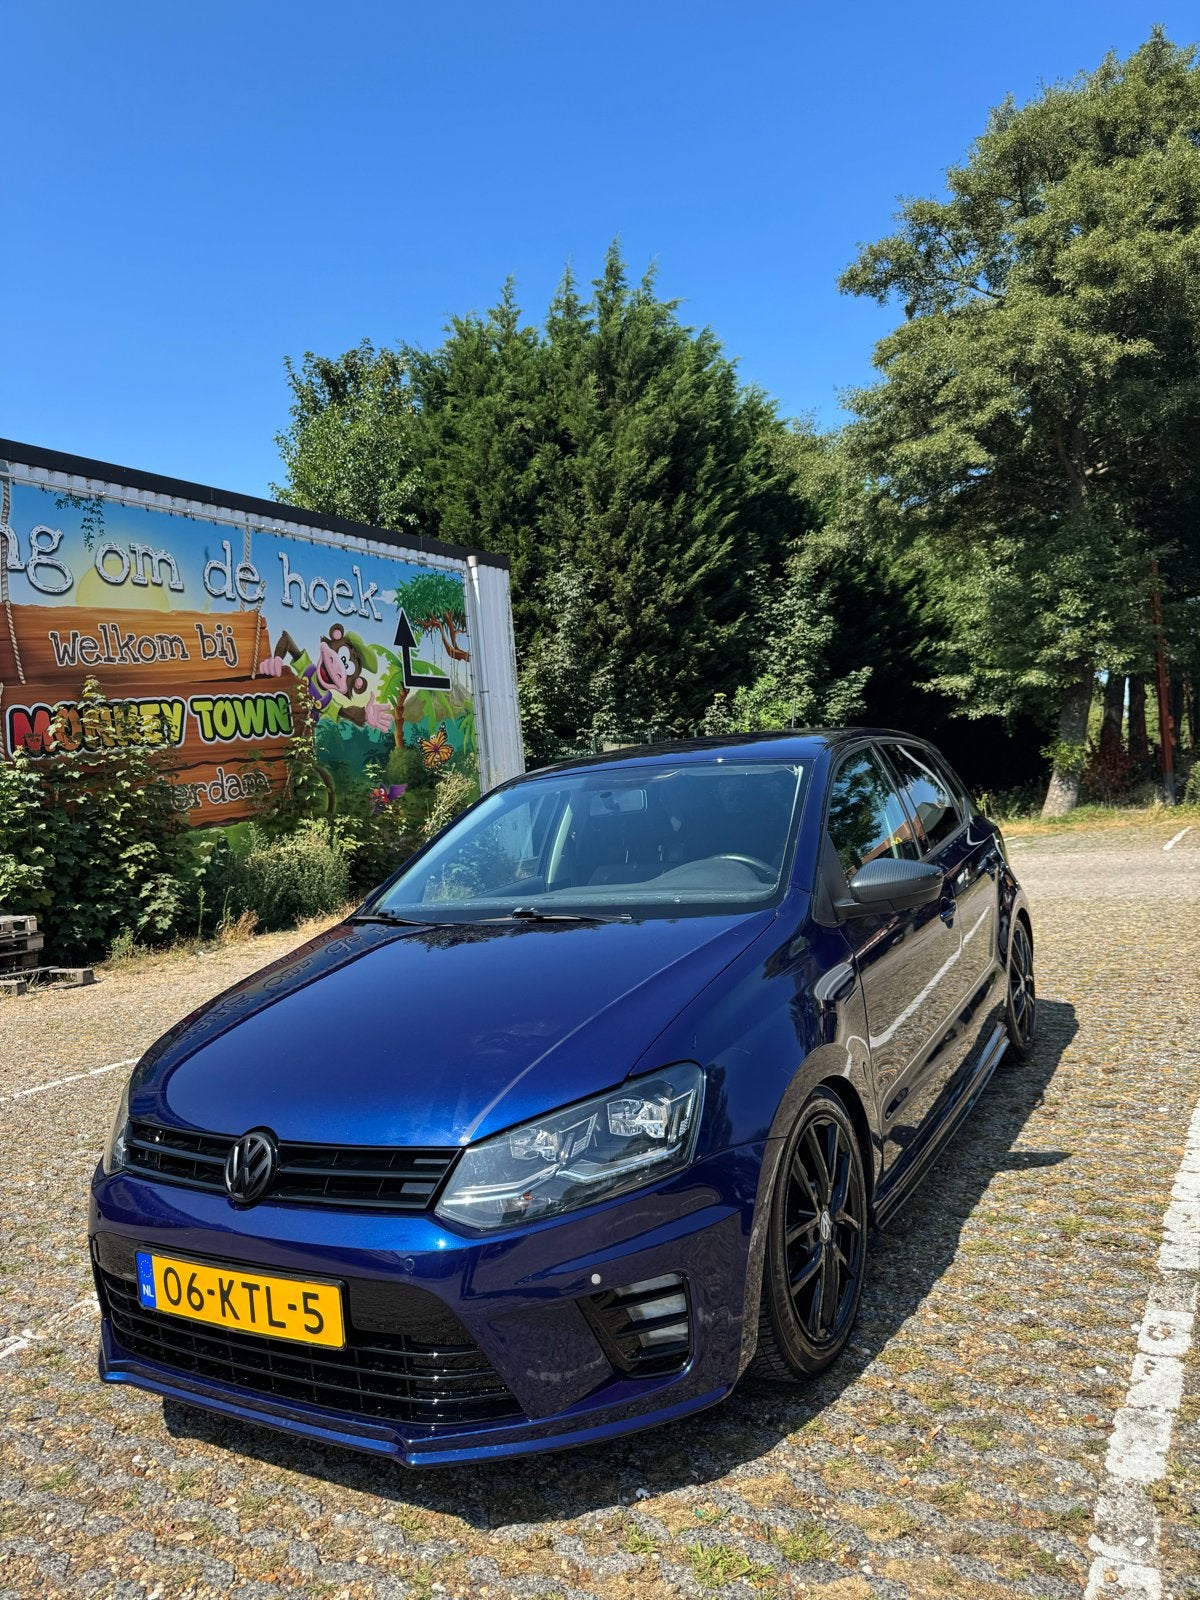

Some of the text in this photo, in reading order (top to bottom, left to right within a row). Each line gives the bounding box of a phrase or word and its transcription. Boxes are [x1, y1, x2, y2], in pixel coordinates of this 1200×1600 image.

[95, 541, 184, 590] om
[203, 539, 265, 602] de
[278, 551, 383, 621] hoek
[195, 622, 239, 668] bij
[191, 692, 291, 743] TOWN
[157, 766, 272, 811] erdam
[142, 1283, 155, 1298] NL
[163, 1266, 324, 1335] 06-KTL-5
